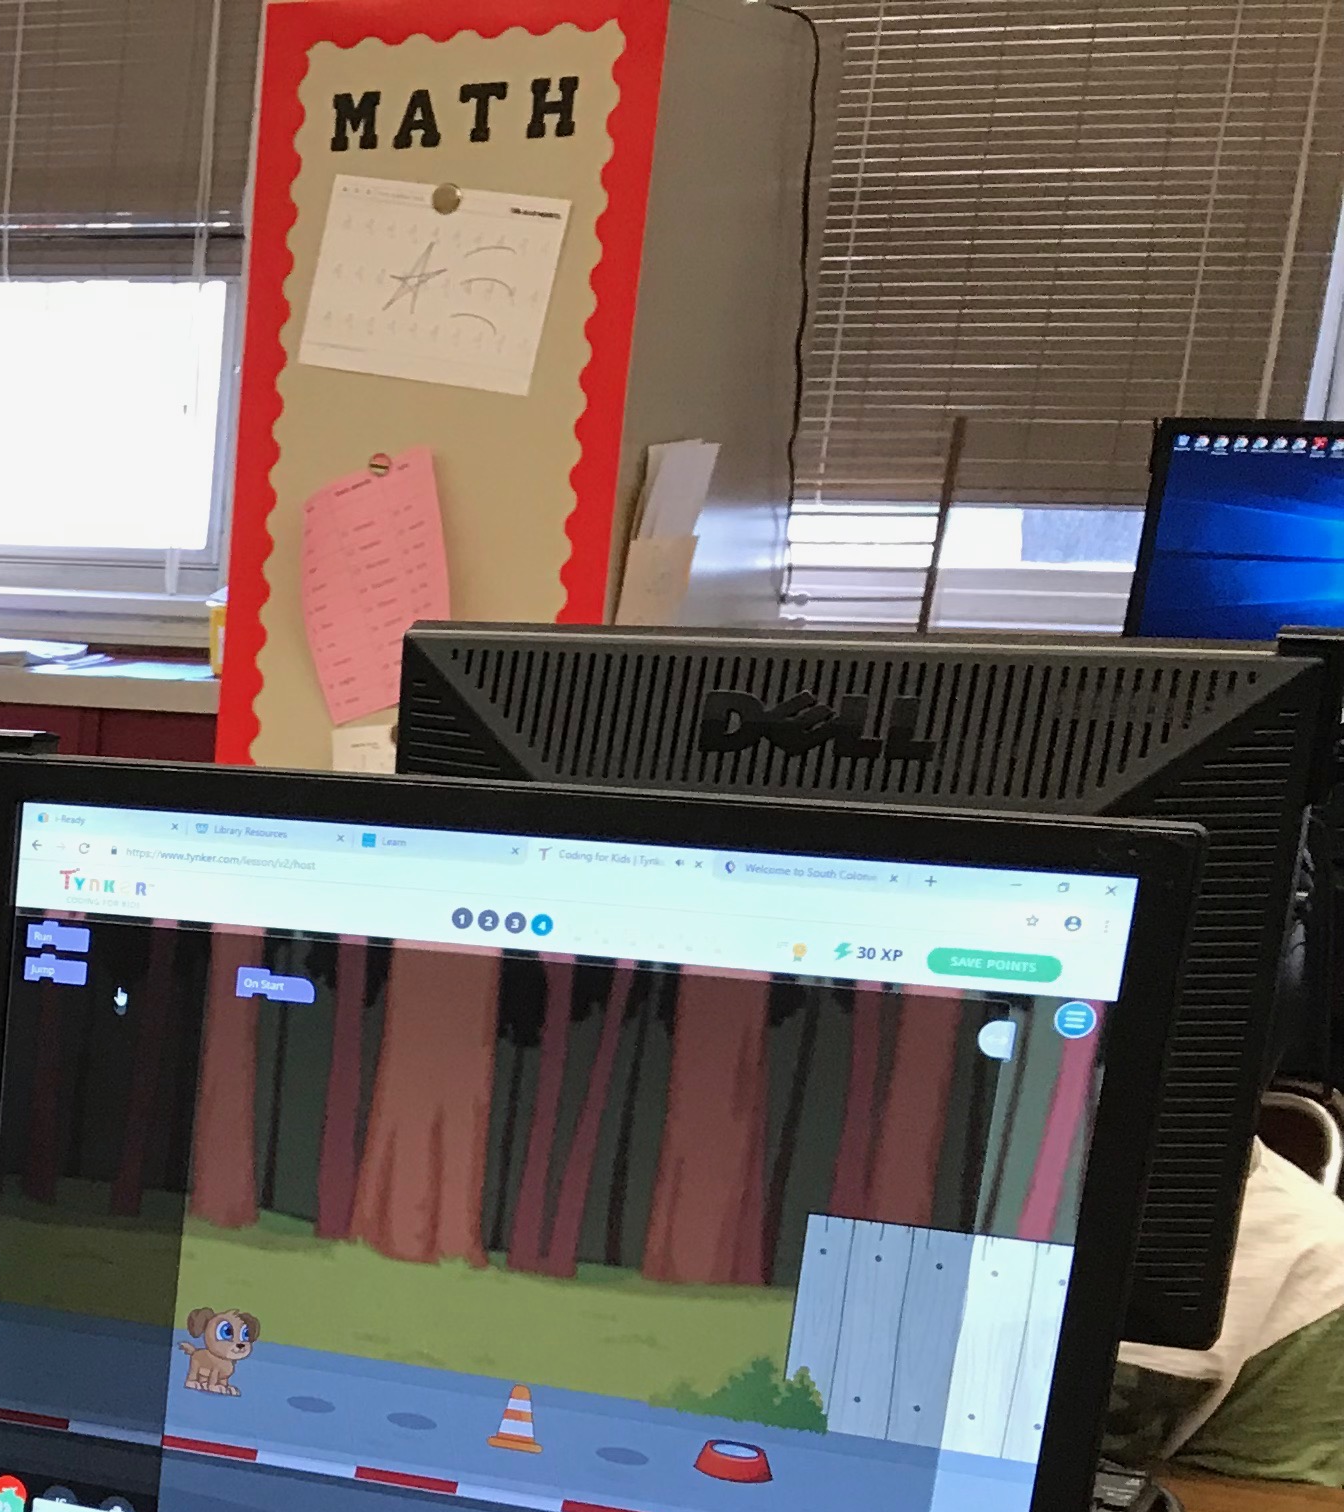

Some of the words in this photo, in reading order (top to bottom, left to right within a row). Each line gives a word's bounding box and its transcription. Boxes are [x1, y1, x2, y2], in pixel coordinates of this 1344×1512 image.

[330, 75, 579, 152] MATH
[697, 688, 936, 761] DELL
[214, 824, 243, 838] Library
[245, 826, 288, 839] Resources
[558, 849, 593, 863] Coding
[595, 851, 609, 862] for
[610, 853, 631, 865] Kids
[745, 863, 791, 876] Welcome
[806, 866, 837, 879] South
[33, 931, 52, 943] Run
[856, 945, 877, 960] 30
[880, 948, 903, 963] XP
[29, 964, 55, 977] Jump
[950, 955, 983, 970] SAVE
[985, 957, 1037, 973] POINTS
[243, 977, 259, 990] On
[260, 979, 285, 992] Start
